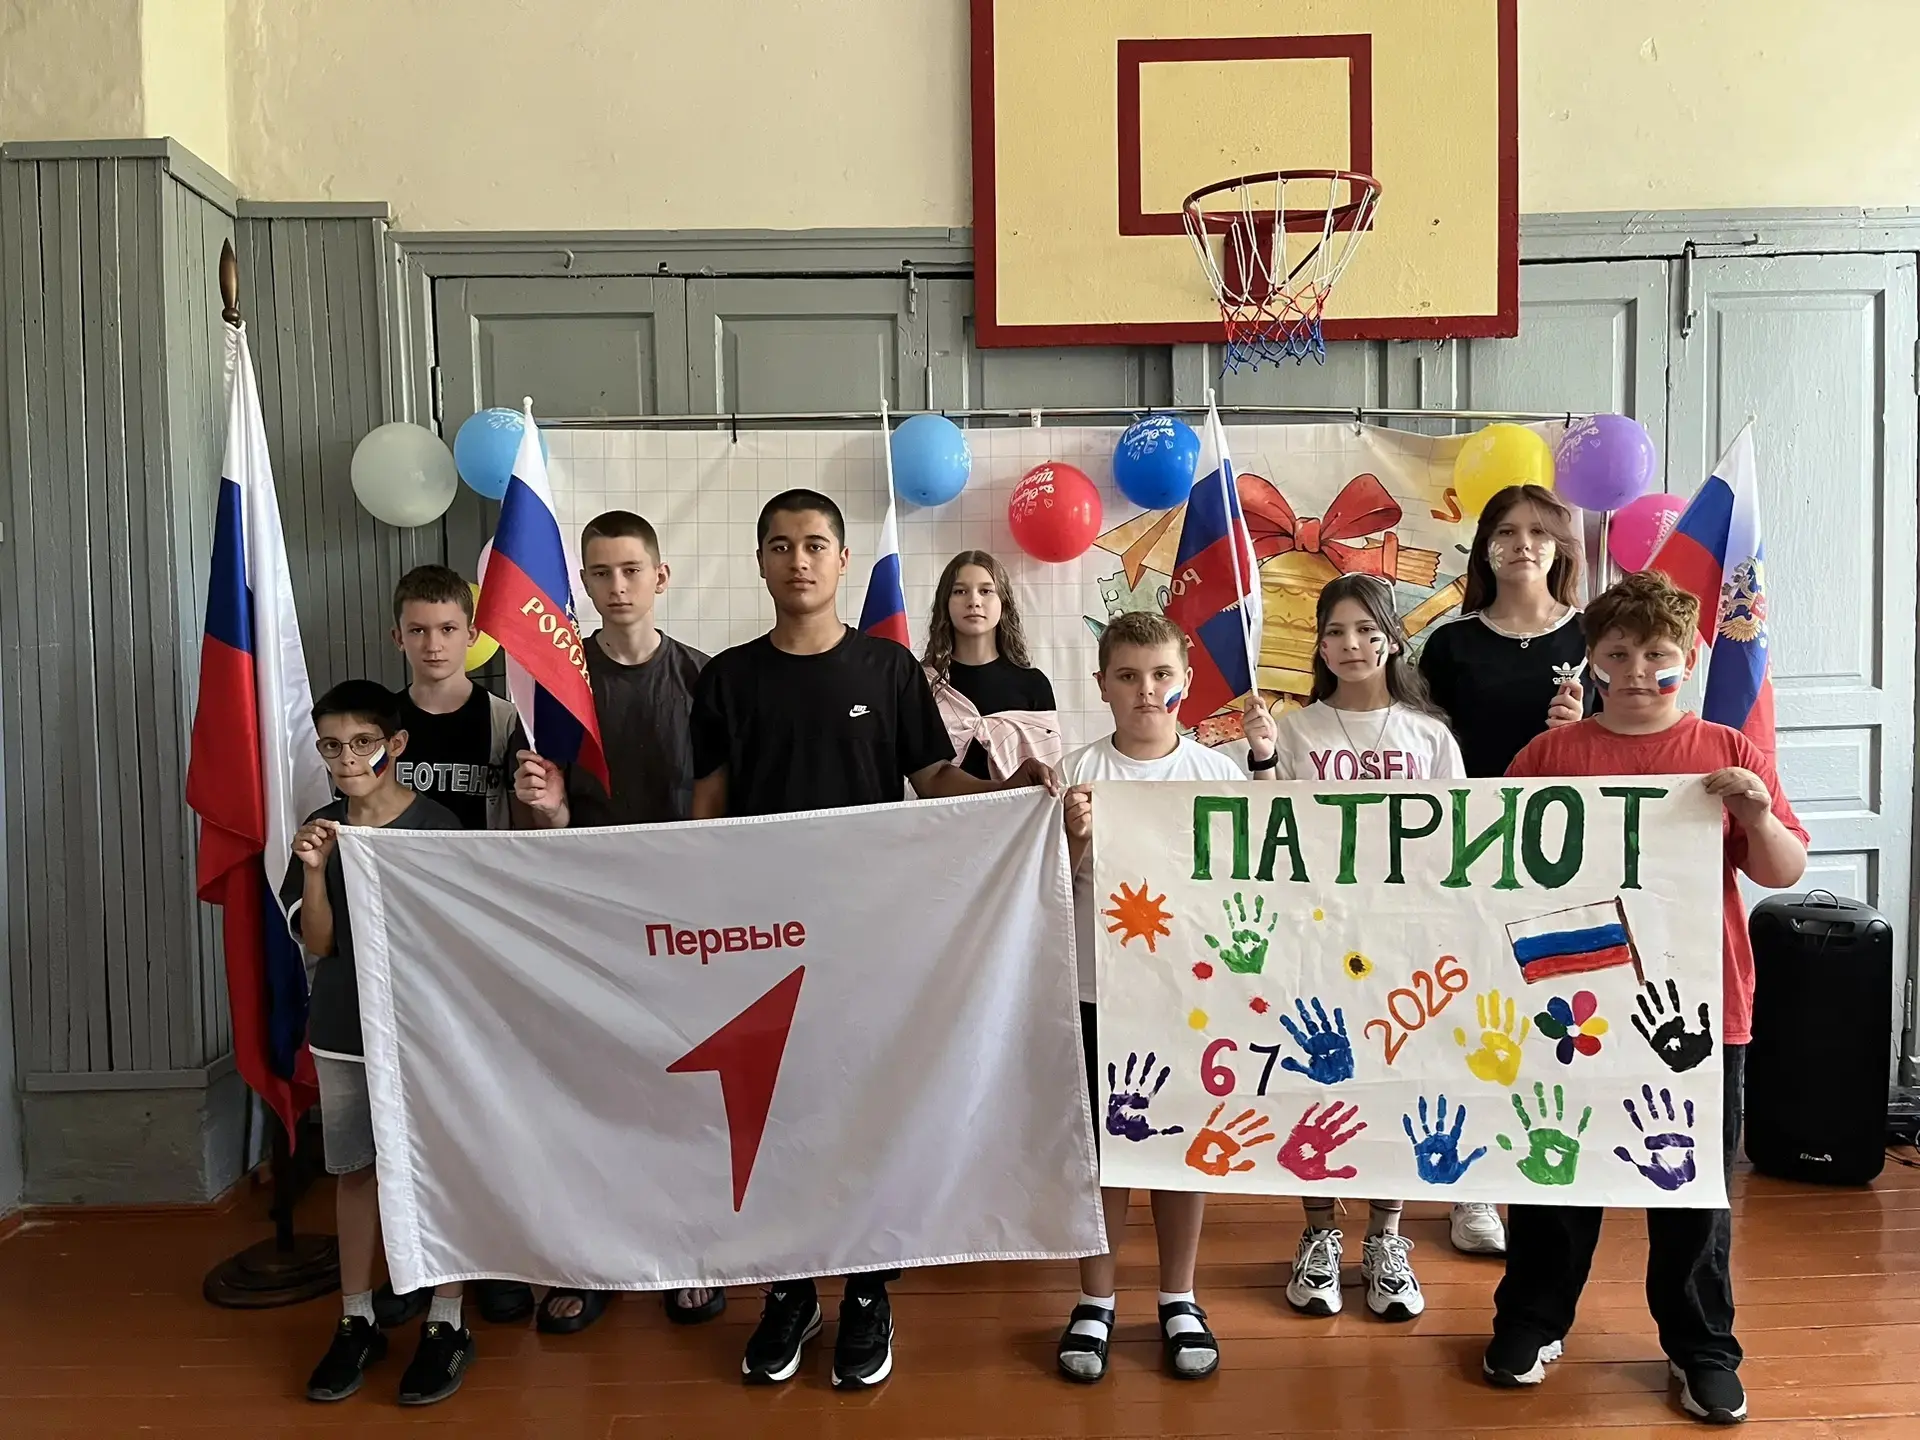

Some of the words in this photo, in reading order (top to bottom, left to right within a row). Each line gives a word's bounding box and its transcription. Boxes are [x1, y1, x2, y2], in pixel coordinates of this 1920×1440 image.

[1191, 785, 1669, 890] ПАТРИОТ
[645, 921, 806, 965] Первые
[1364, 955, 1469, 1065] 2026
